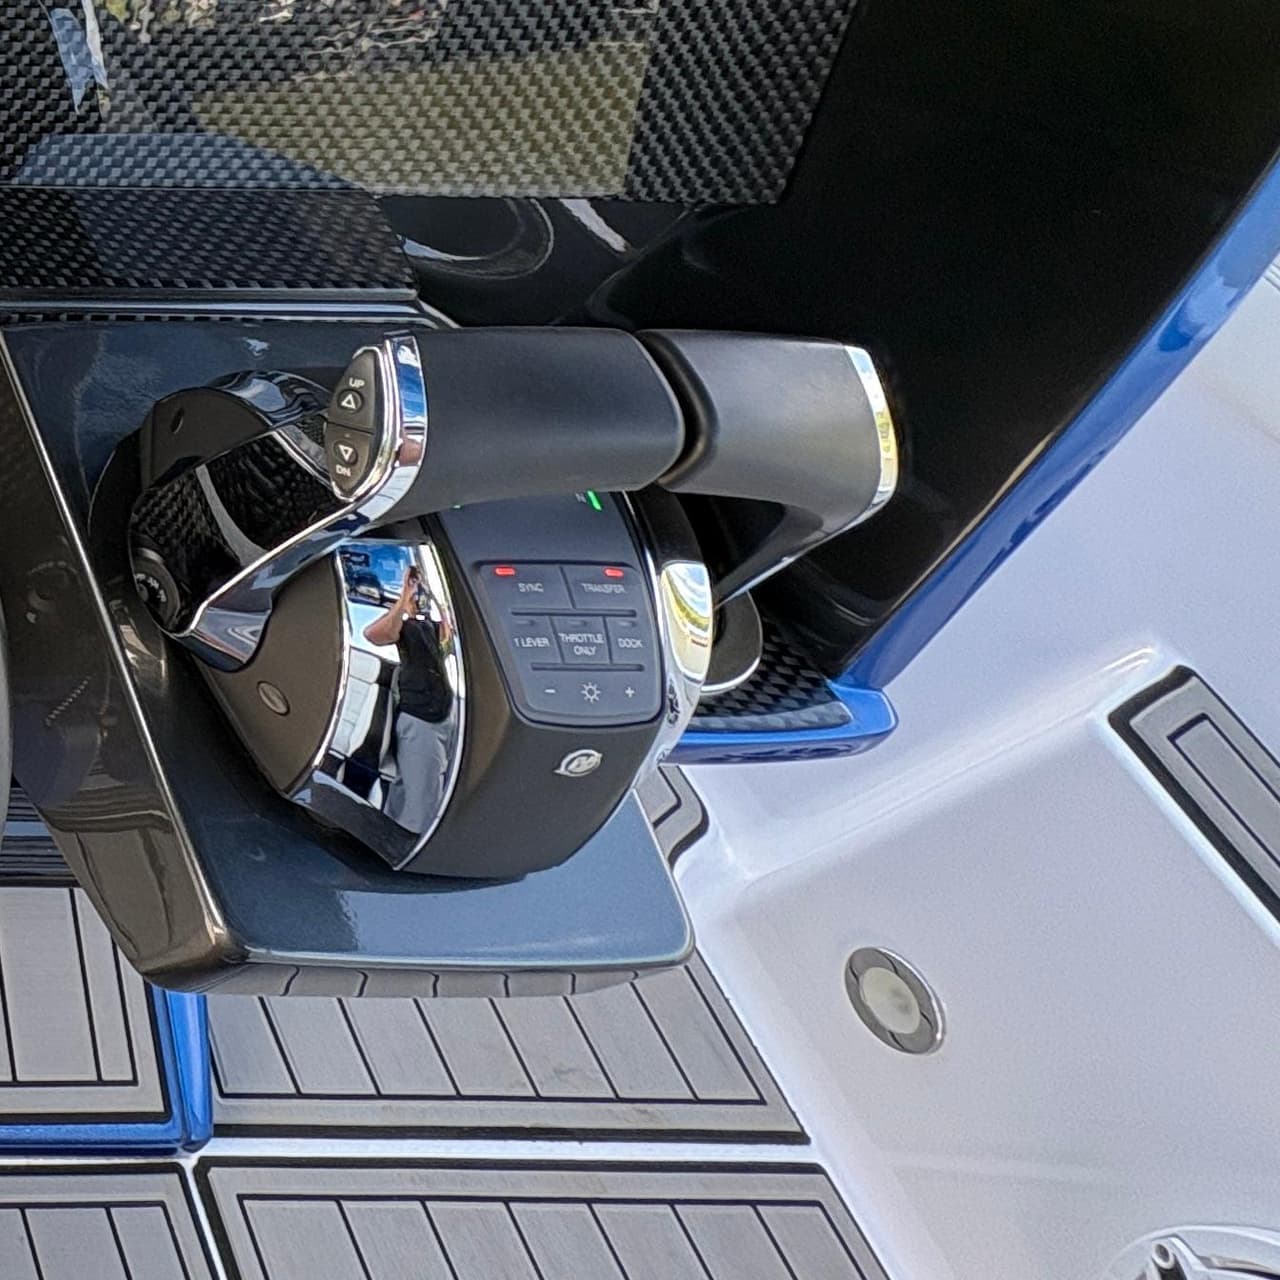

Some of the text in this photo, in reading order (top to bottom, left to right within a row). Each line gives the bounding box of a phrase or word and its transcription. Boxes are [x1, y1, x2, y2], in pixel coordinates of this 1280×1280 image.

[349, 377, 365, 388] UP
[336, 464, 351, 477] DN
[517, 582, 544, 593] SYNC
[581, 583, 626, 593] TRANSFER
[521, 638, 550, 648] LEVER
[558, 632, 604, 645] THROTTLE
[617, 638, 643, 648] DOCK
[573, 644, 597, 656] ONLY
